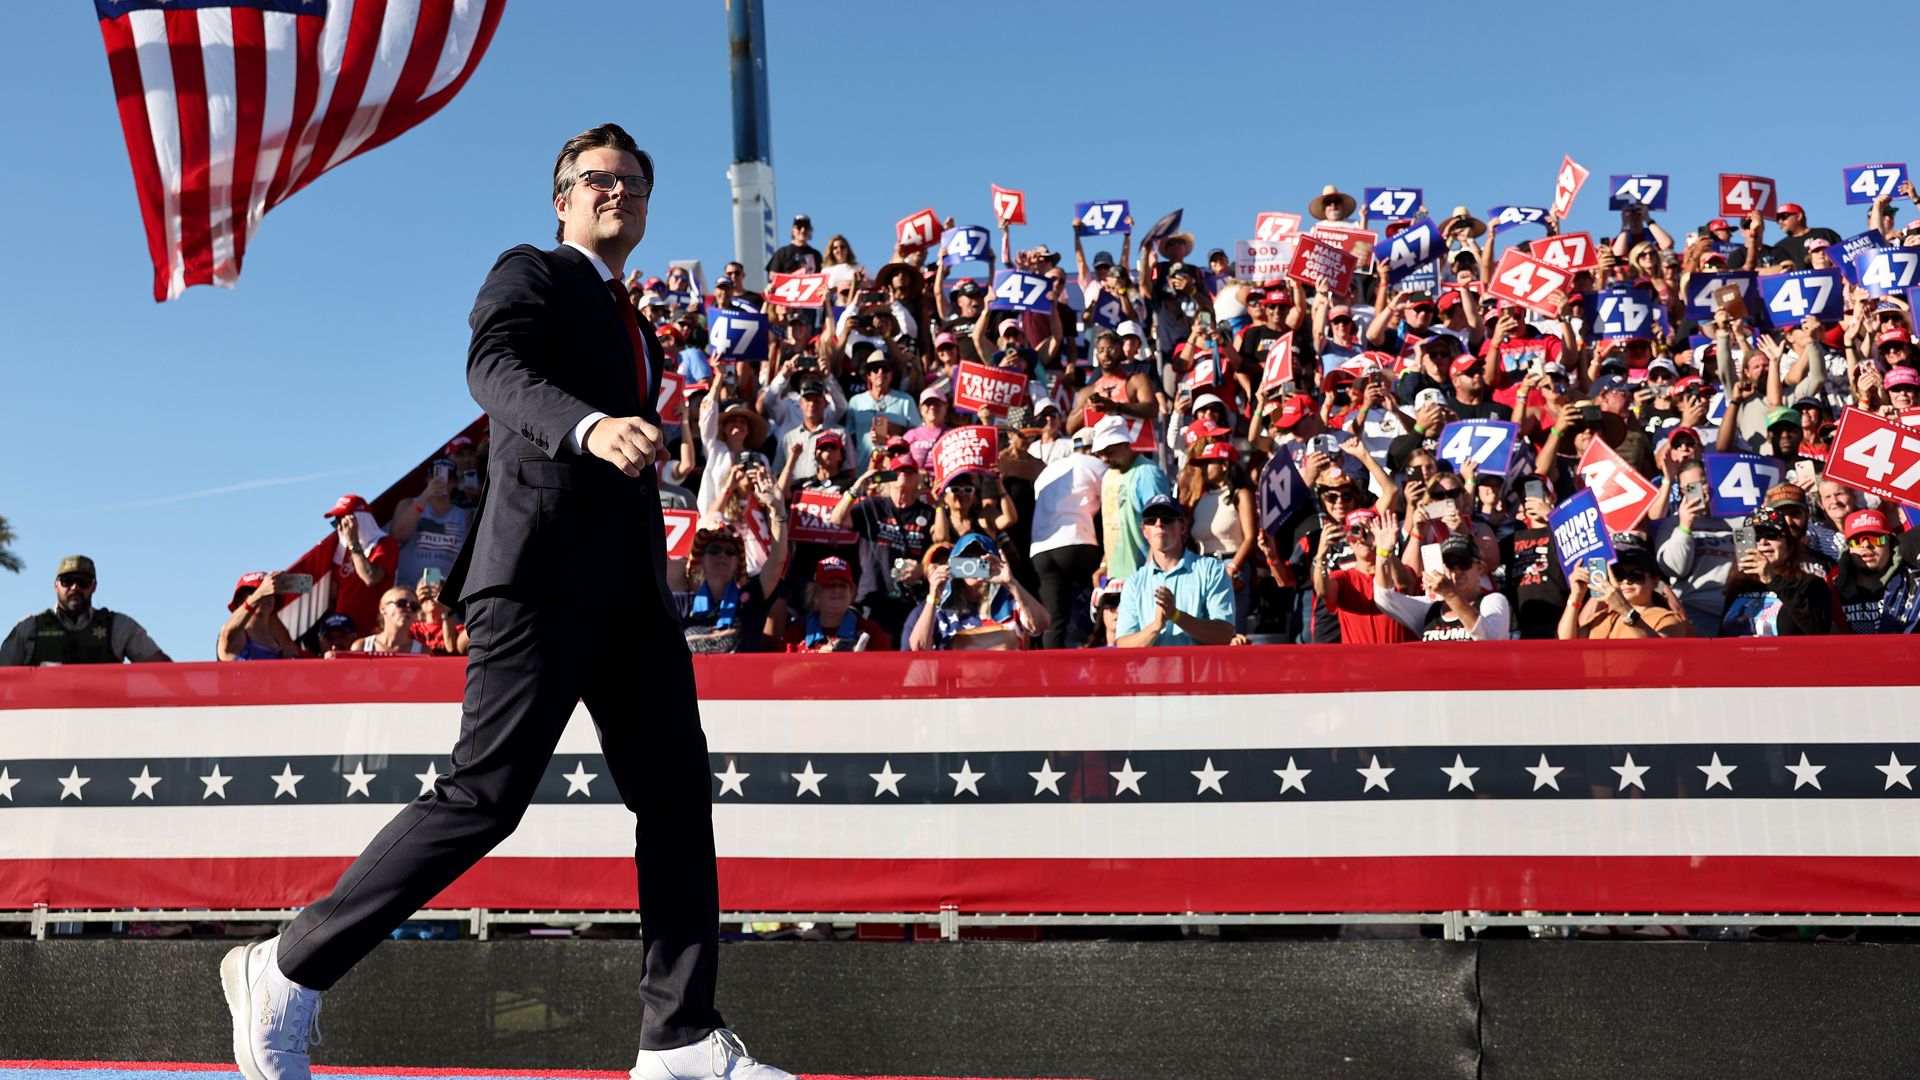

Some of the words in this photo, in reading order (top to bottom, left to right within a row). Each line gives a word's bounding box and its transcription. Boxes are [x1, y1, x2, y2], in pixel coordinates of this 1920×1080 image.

[1615, 178, 1663, 205] 47
[1726, 180, 1771, 211] 47
[1851, 168, 1900, 197] 47
[1082, 204, 1123, 230] 47
[1369, 191, 1416, 215] 47
[1499, 206, 1543, 225] 47
[901, 215, 933, 246] 47
[948, 230, 987, 256] 47
[1257, 216, 1295, 241] 47
[1317, 231, 1349, 241] TRUMP
[1248, 247, 1279, 257] GOD
[1314, 244, 1343, 262] MAKE
[1390, 224, 1430, 271] 47
[1542, 238, 1587, 270] 47
[1843, 235, 1872, 253] MAKE
[1301, 250, 1347, 274] AMERICA
[1305, 260, 1340, 279] GREAT
[1862, 253, 1919, 288] 47
[775, 278, 823, 301] 47
[996, 274, 1047, 305] 47
[1500, 261, 1565, 303] 47
[1769, 276, 1834, 317] 47
[1593, 297, 1649, 335] 47
[709, 316, 760, 356] 47
[656, 378, 676, 417] 7
[961, 372, 1021, 396] TRUMP
[965, 384, 1013, 405] VANCE
[942, 429, 977, 448] MAKE
[1442, 426, 1508, 465] 47
[1843, 427, 1920, 491] 47
[1262, 465, 1291, 531] 47
[1580, 458, 1648, 514] 47
[1717, 462, 1780, 506] 47
[1871, 486, 1893, 498] 2024
[665, 515, 690, 552] 7
[1553, 507, 1599, 548] TRUMP
[1560, 527, 1599, 560] VANCE
[1841, 603, 1863, 613] THE
